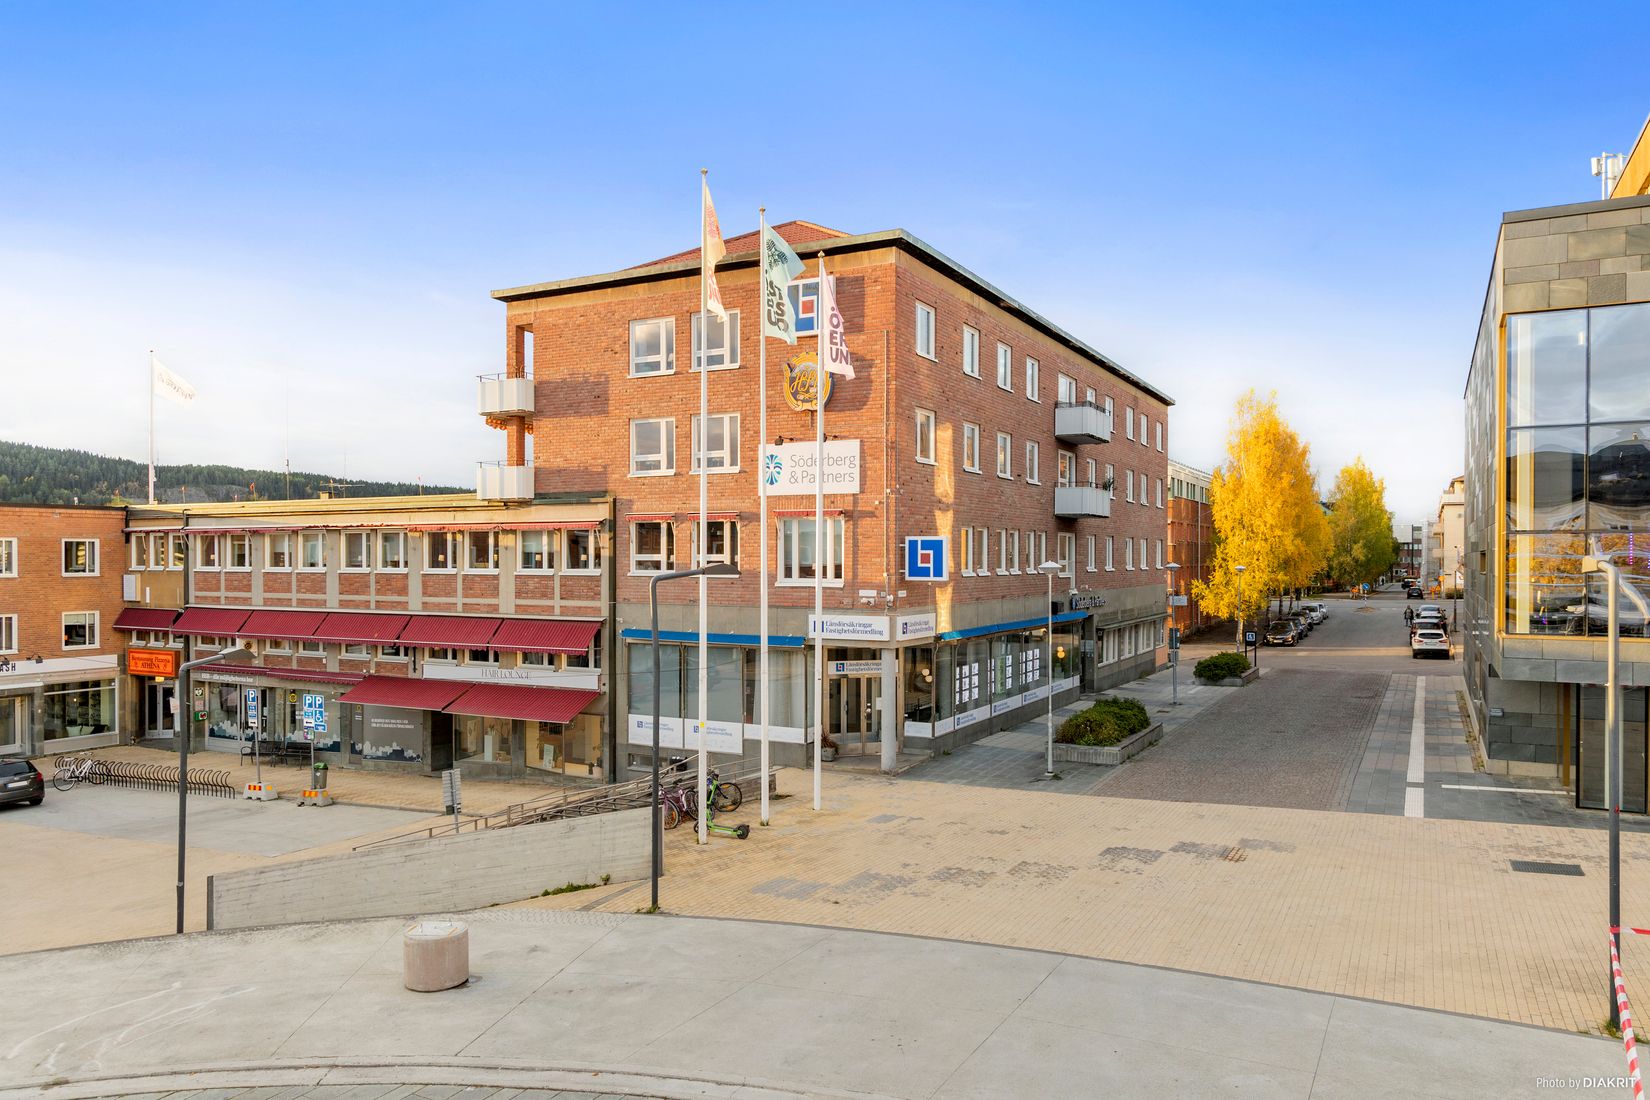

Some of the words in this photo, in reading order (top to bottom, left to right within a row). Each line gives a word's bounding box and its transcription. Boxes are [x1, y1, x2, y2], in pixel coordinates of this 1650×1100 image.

[830, 347, 851, 366] UN
[789, 471, 798, 485] &
[801, 471, 855, 484] Patners
[826, 620, 873, 630] Länsförsäkringar
[825, 627, 884, 636] Fastighetsförmedling
[140, 661, 160, 670] ATHENA
[481, 668, 499, 679] HAIR
[249, 690, 255, 702] P
[305, 695, 313, 709] P
[316, 697, 323, 709] P
